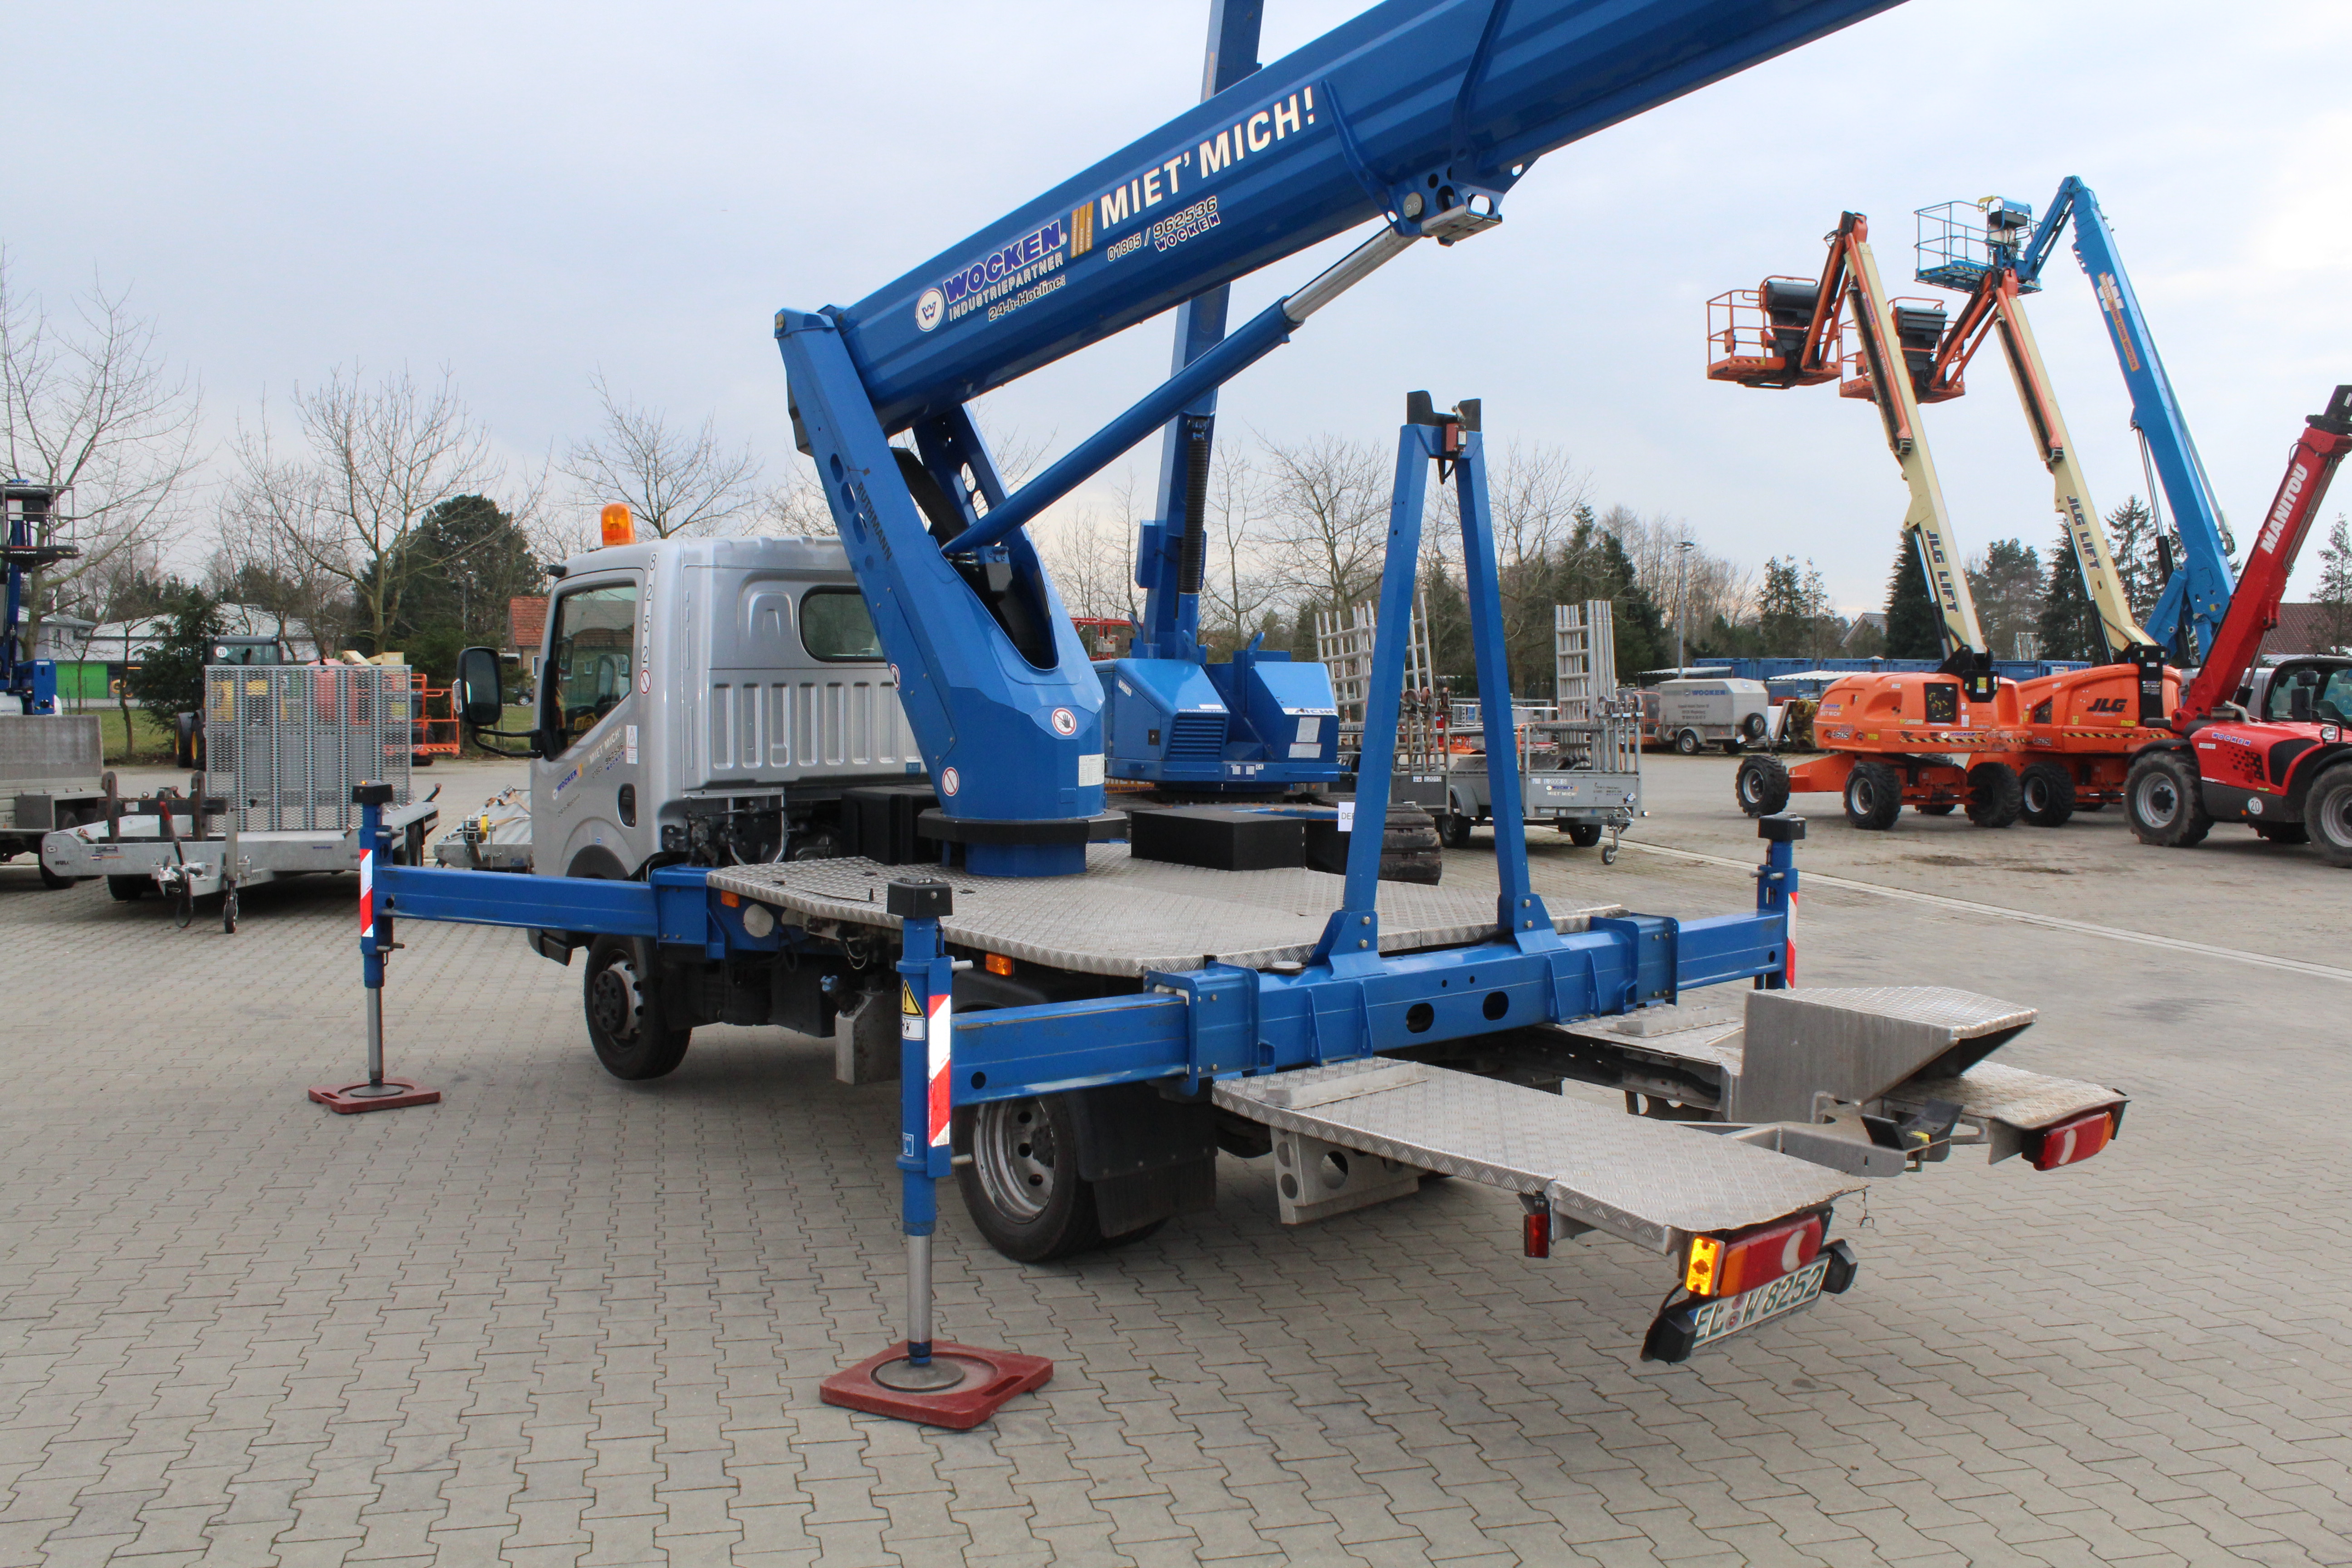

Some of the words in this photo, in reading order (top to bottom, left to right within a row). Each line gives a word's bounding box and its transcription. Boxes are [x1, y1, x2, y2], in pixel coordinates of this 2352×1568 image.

[1199, 86, 1316, 179] MICH!
[1107, 232, 1142, 262] 01805
[1153, 195, 1218, 239] 962536
[1154, 211, 1221, 253] WOCKEN
[943, 218, 1062, 304] WOCKEN
[949, 251, 1064, 322] INDUSTRIEPARTNER
[989, 274, 1066, 322] 24-h-Hotline:
[857, 482, 893, 561] RUTHMANN
[2066, 495, 2086, 526] JLG
[2078, 531, 2101, 569] LIFT
[2260, 463, 2308, 554] MANITOU
[1925, 529, 1945, 564] JLG
[1936, 570, 1959, 613] LIFT
[2086, 698, 2128, 712] JLG
[604, 727, 622, 750] MICH!
[605, 742, 623, 764] 962536
[2212, 732, 2251, 746] WOCKEN
[557, 768, 578, 793] WOCKEN
[2250, 800, 2260, 812] 20
[1740, 1288, 1764, 1323] W
[1762, 1264, 1825, 1315] 8252
